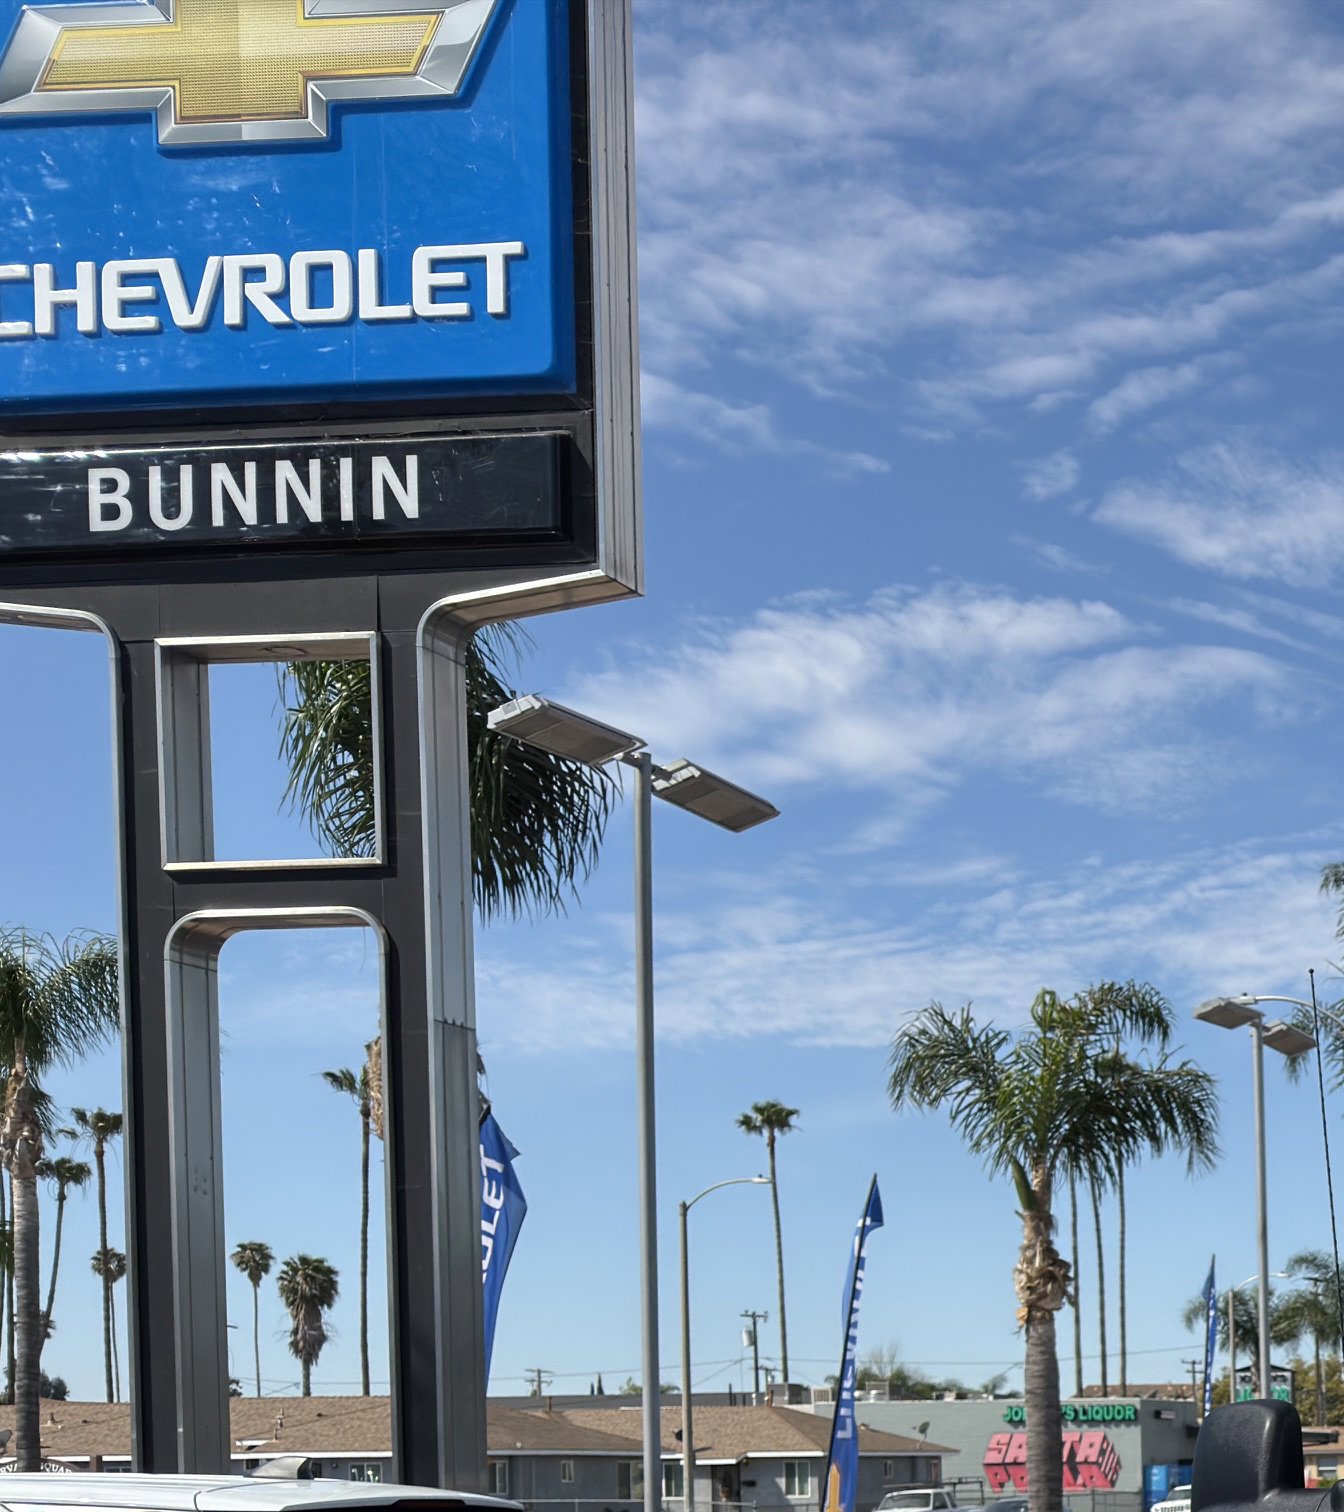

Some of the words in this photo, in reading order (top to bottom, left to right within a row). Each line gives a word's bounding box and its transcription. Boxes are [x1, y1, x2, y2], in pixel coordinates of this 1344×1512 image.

[88, 454, 420, 532] BUNNIN
[1079, 1404, 1136, 1421] LIQUOR
[984, 1431, 1105, 1464] SATA
